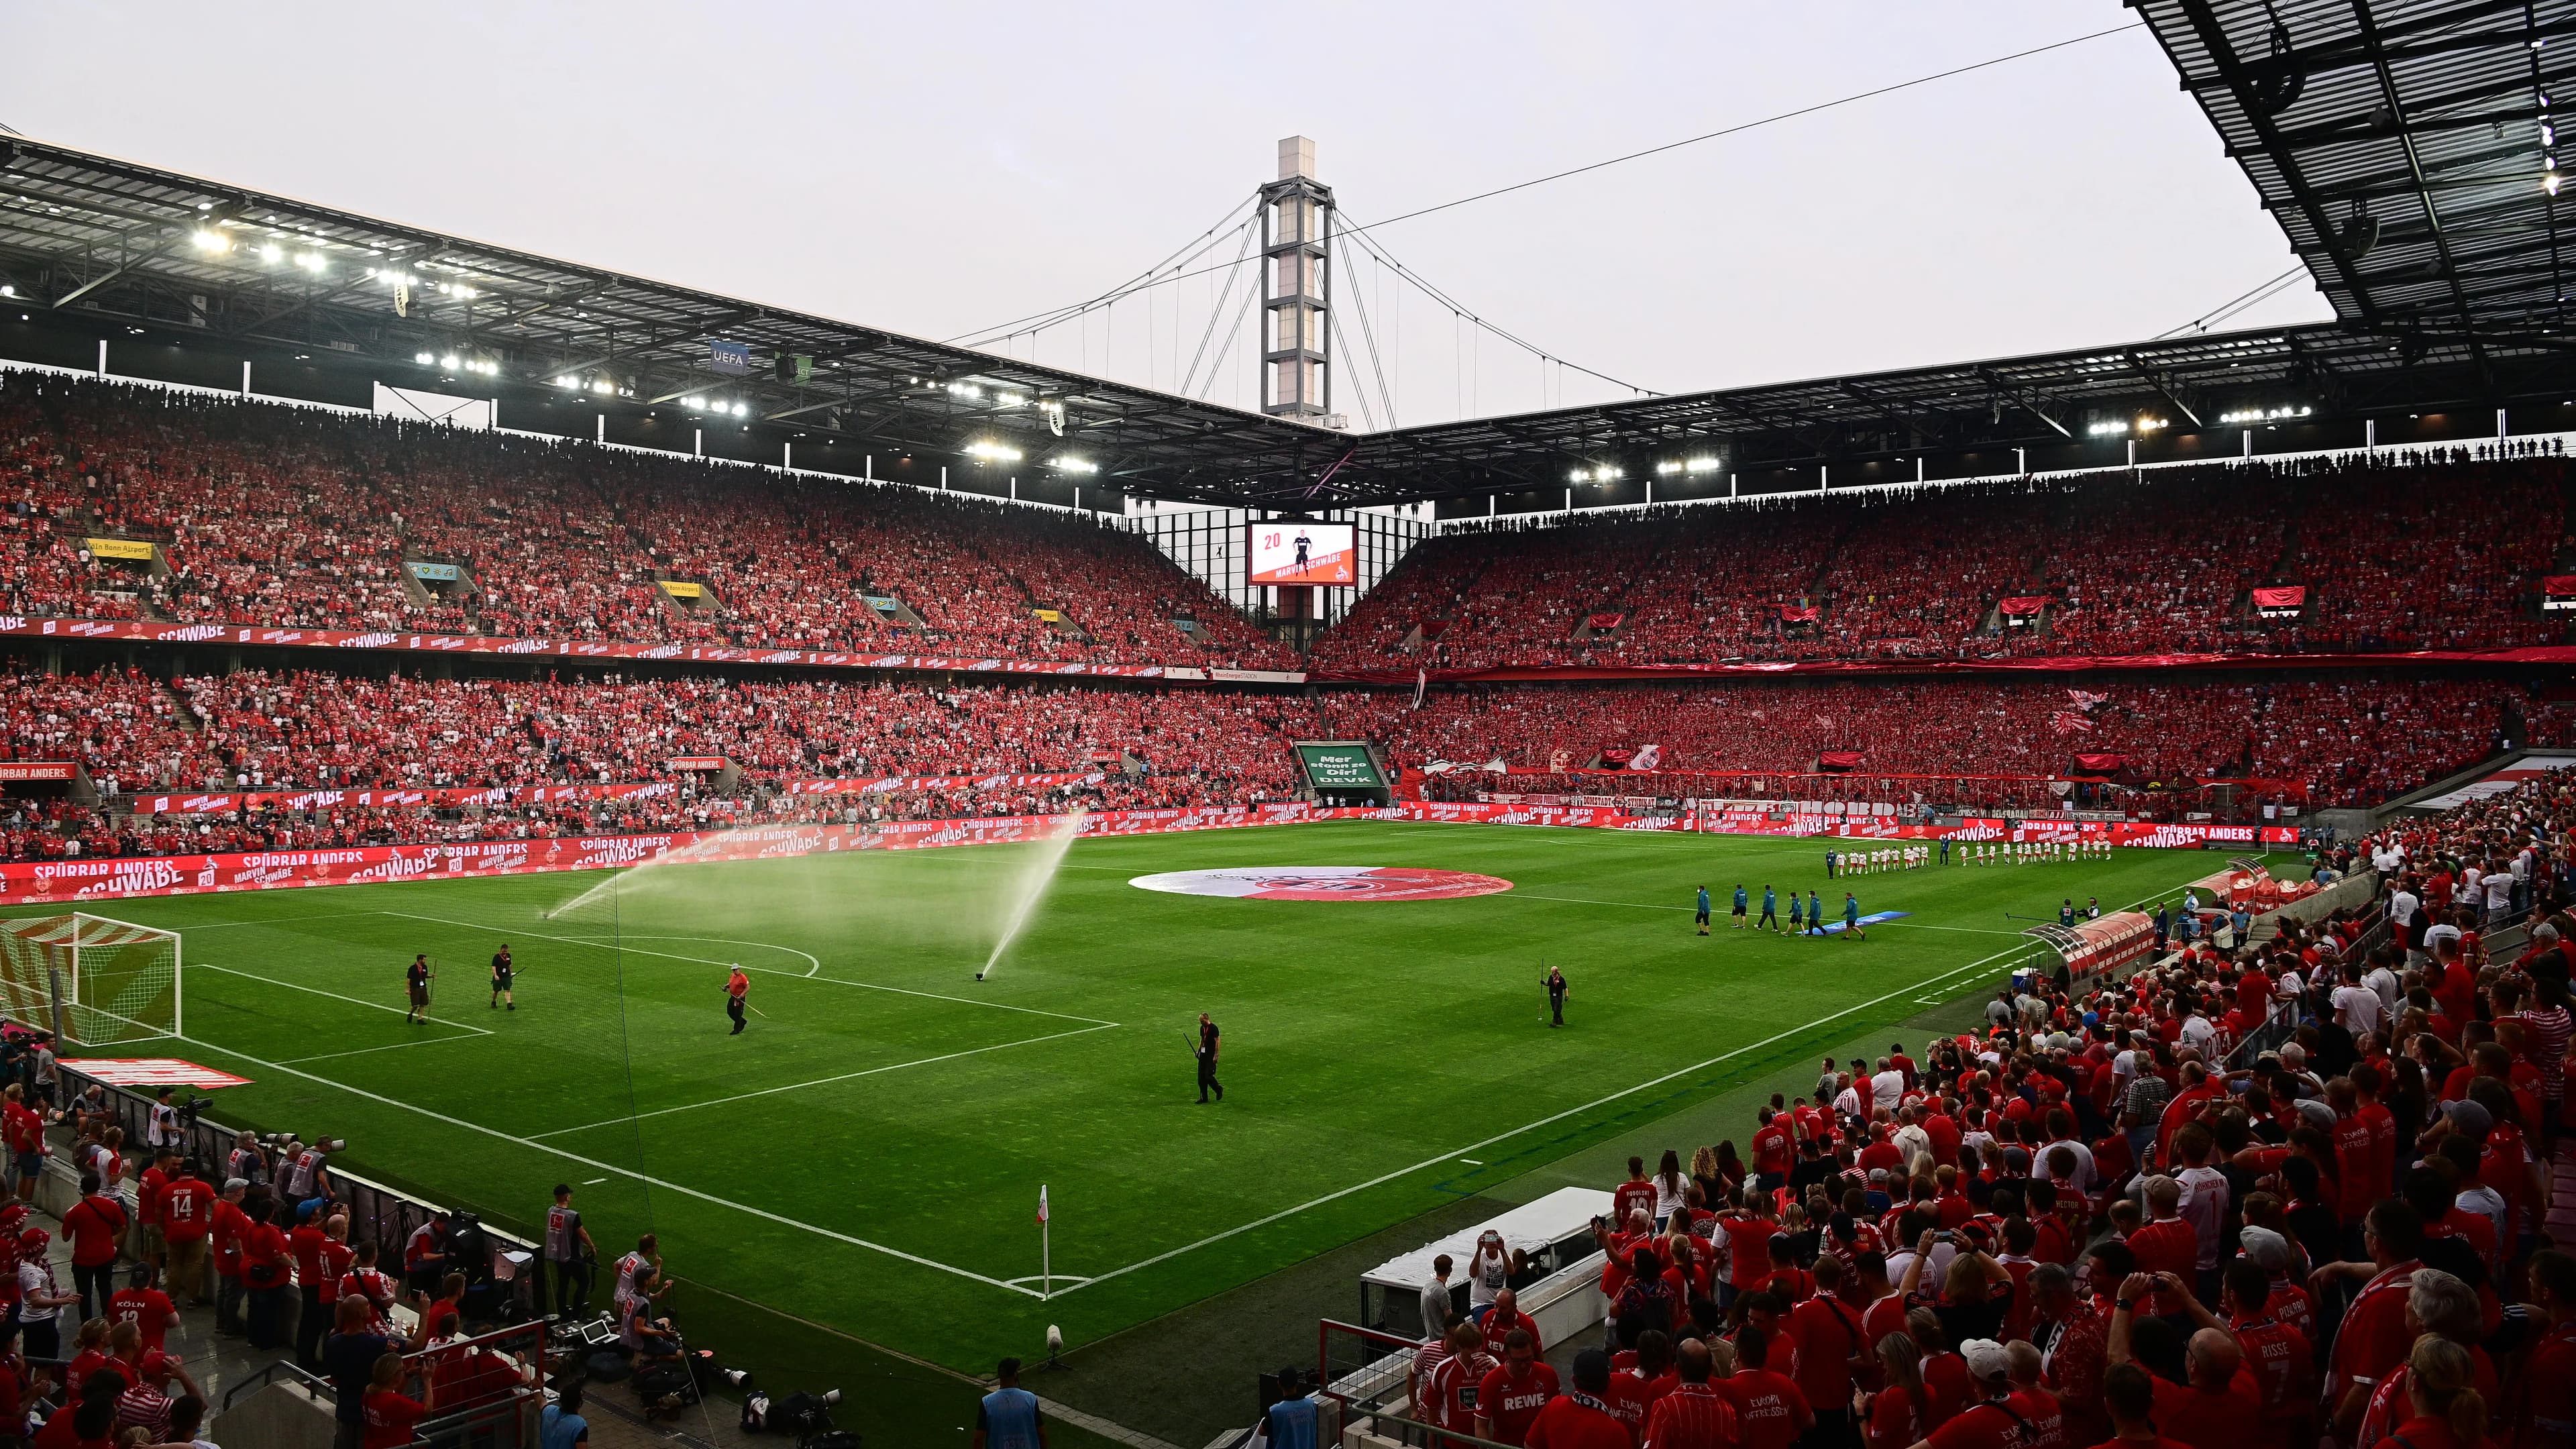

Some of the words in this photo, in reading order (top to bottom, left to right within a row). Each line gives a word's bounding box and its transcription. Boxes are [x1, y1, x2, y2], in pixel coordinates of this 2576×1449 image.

[714, 350, 743, 365] UEFA
[1265, 533, 1280, 550] 20
[105, 543, 121, 551] Bonn
[123, 545, 150, 553] Airport
[1276, 562, 1305, 578] MARVIN
[70, 622, 95, 633] MARVIN
[263, 631, 284, 641] MARVIN
[30, 767, 68, 779] ANDERS.
[183, 795, 209, 808] MARVIN
[1584, 796, 1611, 806] DOMSTADT
[1627, 798, 1655, 808] SYNDIKAT
[1569, 808, 1594, 816] NDERS
[2038, 830, 2060, 841] MARVIN
[2209, 828, 2253, 840] ANDERS
[423, 845, 479, 859] SPRBAR
[478, 853, 504, 870] MARVIN
[234, 866, 266, 883] MARVIN
[22, 896, 53, 904] DERTOUR
[1970, 1039, 1981, 1056] 13
[1626, 1189, 1650, 1197] PODOLSKI
[171, 1195, 193, 1218] 14
[2056, 1200, 2079, 1210] HECTOR
[116, 1300, 146, 1308] KÖLN
[2261, 1341, 2290, 1358] RISSE
[2267, 1359, 2289, 1404] 7
[1504, 1393, 1546, 1411] REWE
